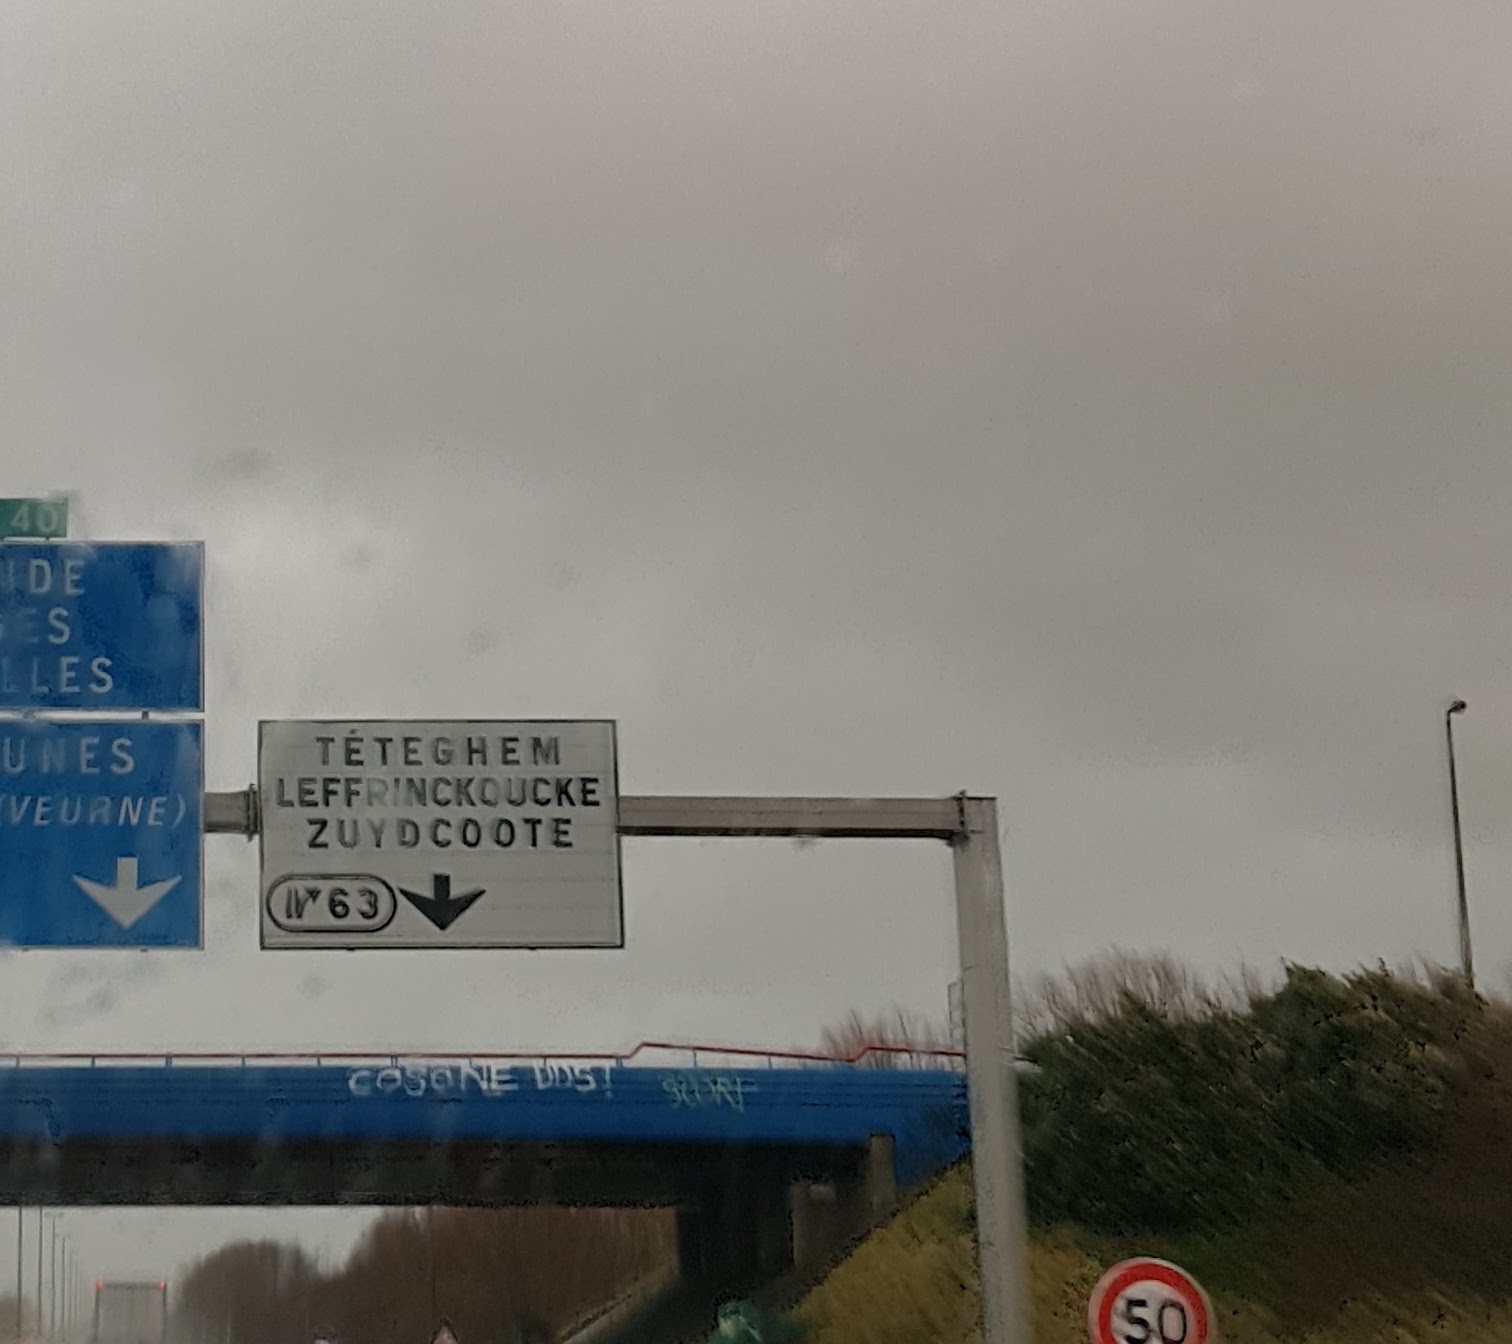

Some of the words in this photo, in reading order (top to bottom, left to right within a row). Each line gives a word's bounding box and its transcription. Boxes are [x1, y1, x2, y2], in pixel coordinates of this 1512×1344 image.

[315, 729, 561, 767] TÉTEGHEM
[275, 777, 601, 809] LEFFRINCKOUCKE
[306, 817, 574, 849] ZUYDCOOTE
[329, 887, 379, 920] 63
